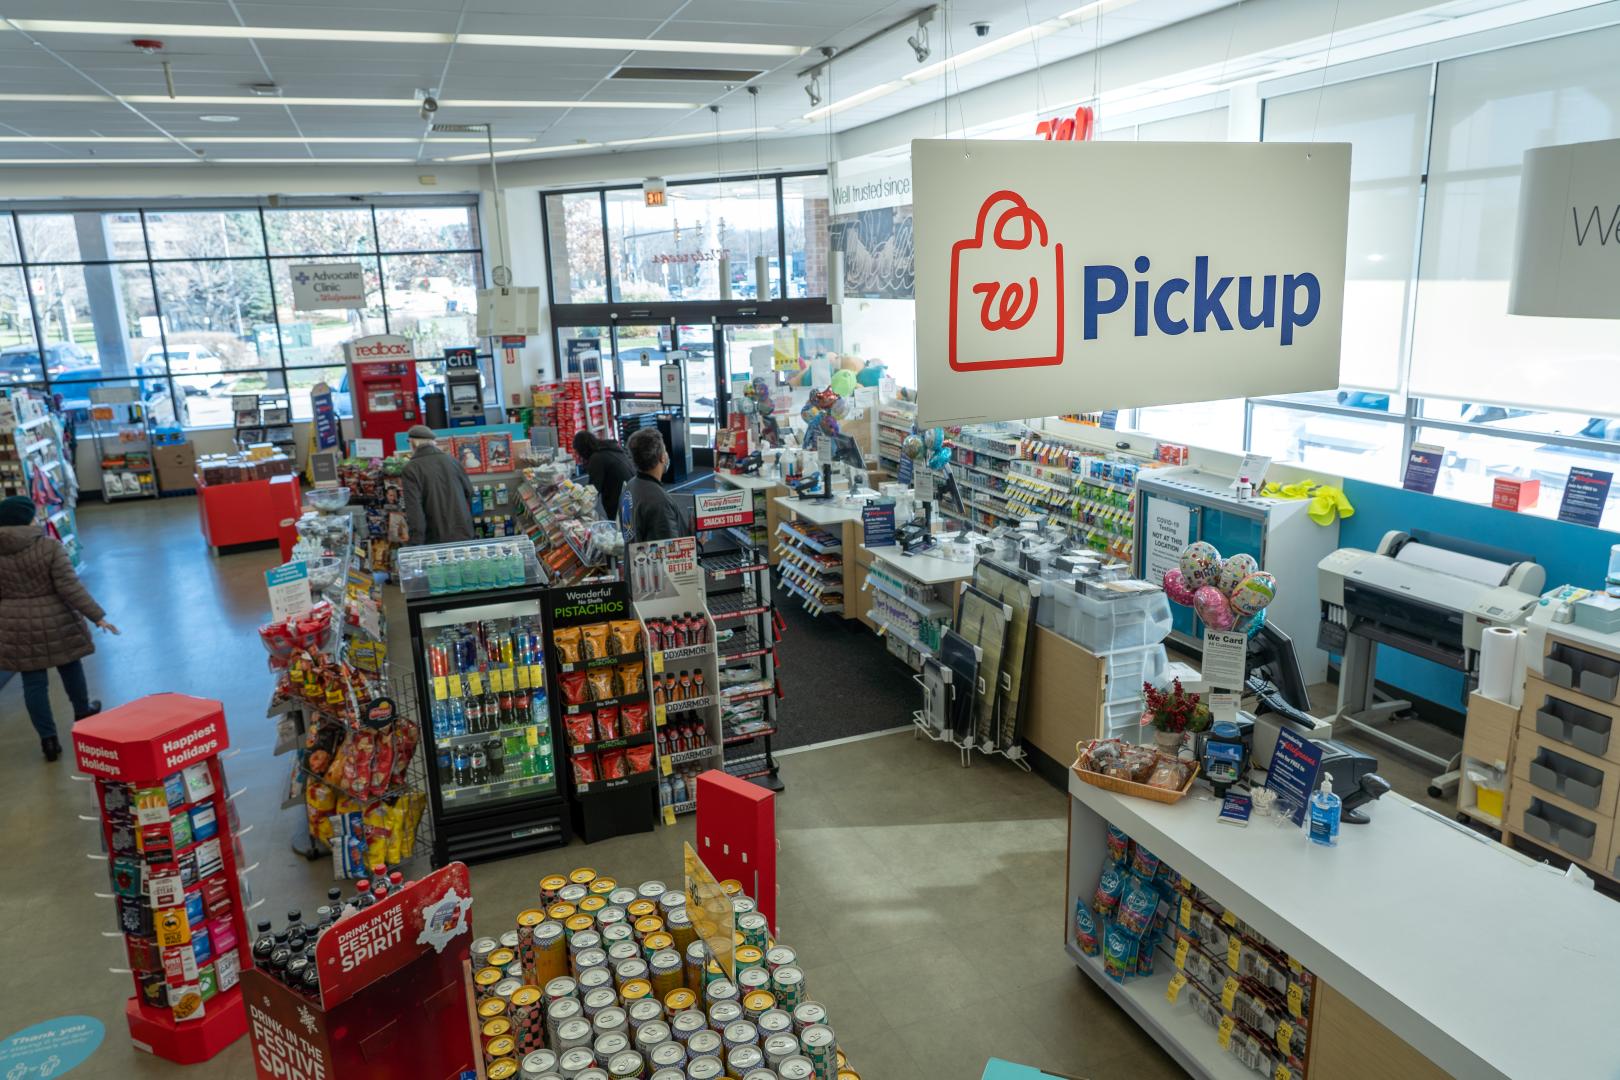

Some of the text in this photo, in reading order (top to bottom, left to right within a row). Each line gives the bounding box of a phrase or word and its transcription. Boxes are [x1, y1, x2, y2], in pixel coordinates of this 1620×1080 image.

[833, 177, 910, 205] Well trusted since
[1573, 204, 1620, 246] W
[312, 271, 359, 281] Advocate
[313, 282, 341, 293] Clinic
[1083, 255, 1321, 346] Pickup
[448, 350, 472, 367] citi
[703, 514, 742, 527] SNACKS TO GO
[1159, 523, 1177, 535] Testing
[1152, 531, 1163, 540] NOT
[1171, 536, 1183, 546] THIS
[1154, 539, 1180, 553] LOCATION
[566, 587, 612, 600] Wonderful
[554, 601, 624, 619] PISTACHIOS
[1207, 633, 1244, 645] We Card
[664, 646, 707, 660] ODYARMOR
[667, 697, 710, 711] ODYARMOR
[162, 723, 216, 753] Happiest
[78, 741, 119, 760] Happiest
[166, 739, 218, 768] Holidays
[671, 748, 713, 763] ODYARMOR
[82, 757, 120, 775] Holidays
[338, 904, 401, 944] DRINK IN THE
[339, 912, 404, 958] FESTIVE
[341, 925, 404, 973] SPIRIT
[12, 1024, 86, 1046] Thank you
[250, 1004, 324, 1064] DRINK IN THE
[252, 1019, 326, 1080] FESTIVE
